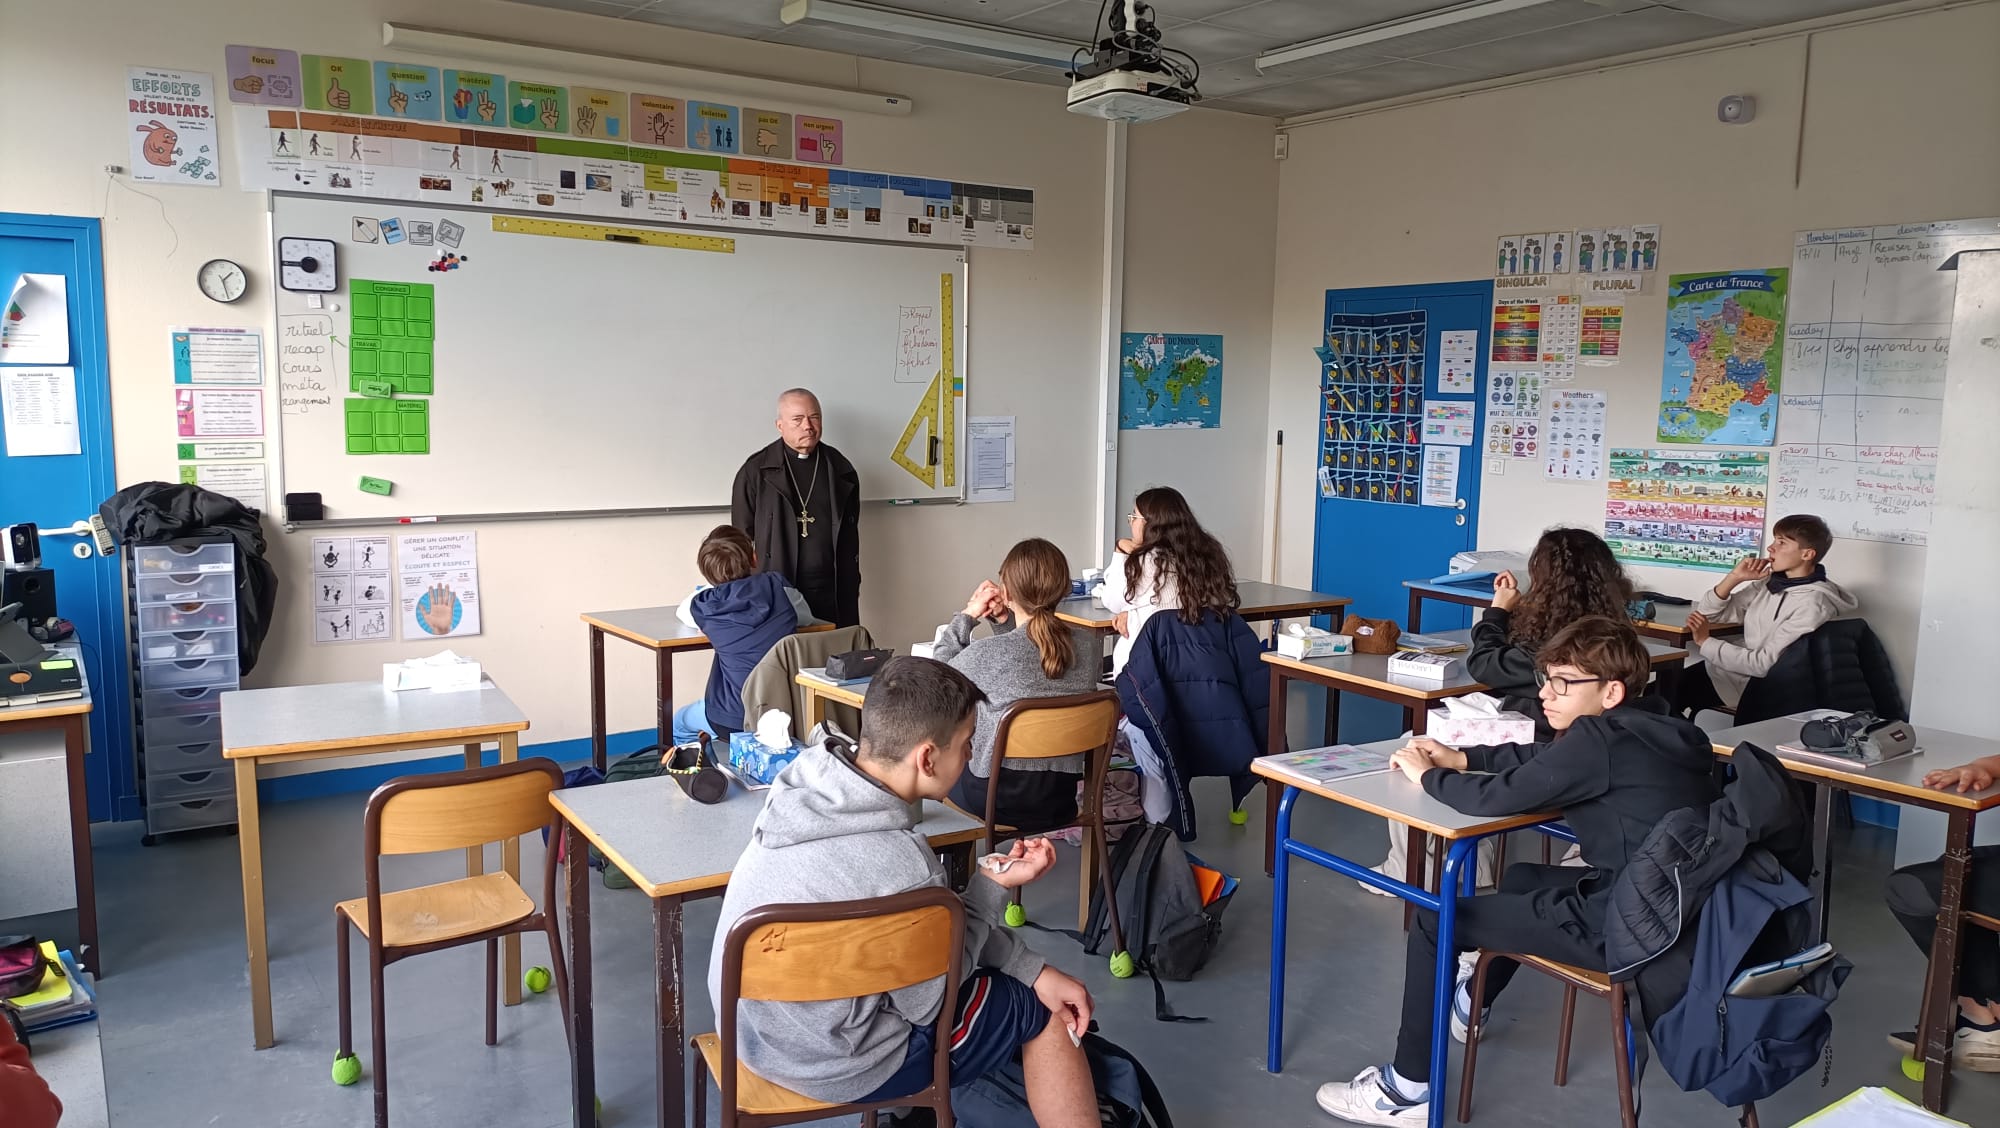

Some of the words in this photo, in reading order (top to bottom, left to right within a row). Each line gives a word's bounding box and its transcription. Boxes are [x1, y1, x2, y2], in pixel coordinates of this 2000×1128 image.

[251, 55, 275, 65] focus
[330, 65, 343, 73] OK
[391, 72, 426, 82] question
[459, 74, 491, 86] matériel
[132, 78, 201, 97] EFFORTS
[520, 83, 557, 97] mouchoirs
[590, 97, 609, 107] boire
[641, 100, 675, 111] volontaire
[129, 98, 214, 119] RÉSULTATS.
[701, 109, 728, 119] toilettes
[816, 122, 835, 132] urgent
[1558, 234, 1564, 242] It
[1581, 235, 1593, 243] We
[1607, 233, 1621, 242] You
[1635, 231, 1654, 241] They
[1526, 238, 1539, 247] She
[1496, 276, 1547, 288] SINGULAR
[1592, 279, 1636, 291] PLURAL
[1689, 282, 1715, 293] Carte
[1715, 280, 1728, 289] de
[1729, 277, 1765, 289] France
[375, 284, 407, 293] CONSIGNES
[284, 321, 326, 338] rituel
[355, 340, 379, 348] TRAVAIL
[1168, 336, 1177, 345] DU
[1177, 336, 1200, 345] MONDE
[283, 344, 325, 362] recap
[1864, 339, 1926, 360] apprendre
[282, 362, 323, 374] Cours
[281, 375, 327, 392] méta
[1562, 391, 1594, 400] Weathers
[281, 396, 332, 414] rangement
[404, 537, 426, 545] GÉRER
[438, 535, 465, 543] CONFLIT
[421, 552, 450, 560] DÉLICATE
[442, 560, 471, 568] RESPECT
